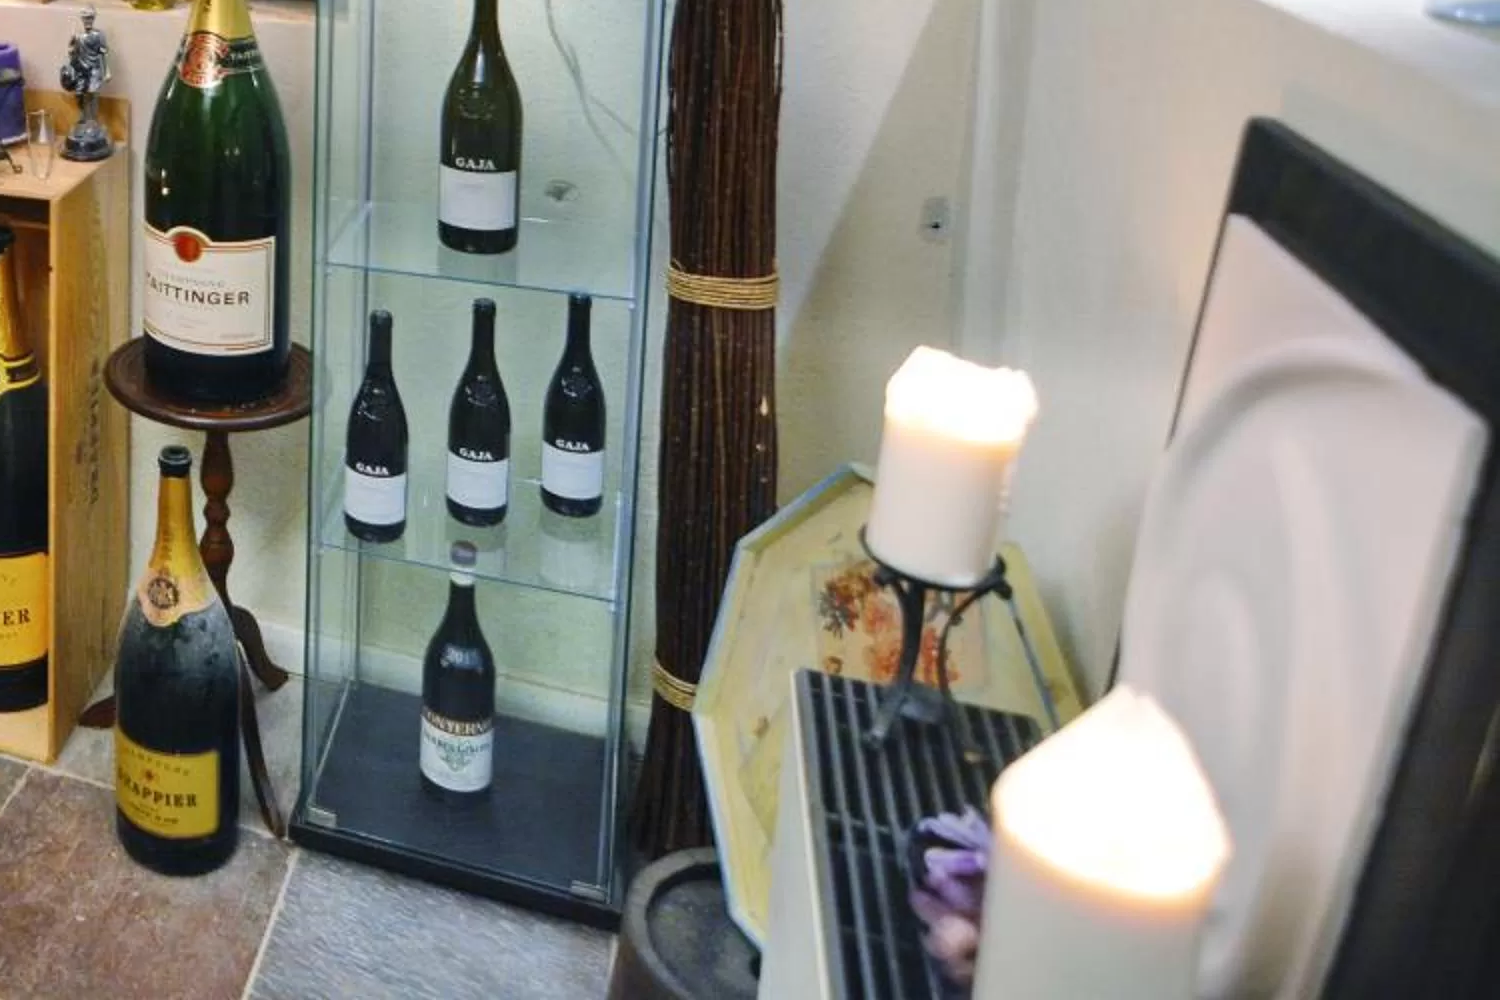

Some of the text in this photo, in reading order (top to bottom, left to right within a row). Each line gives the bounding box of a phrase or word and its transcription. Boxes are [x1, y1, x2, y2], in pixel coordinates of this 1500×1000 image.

[454, 156, 496, 171] GAJA
[554, 437, 590, 452] GAJA
[459, 447, 494, 462] GAJA
[355, 462, 390, 477] GAJA
